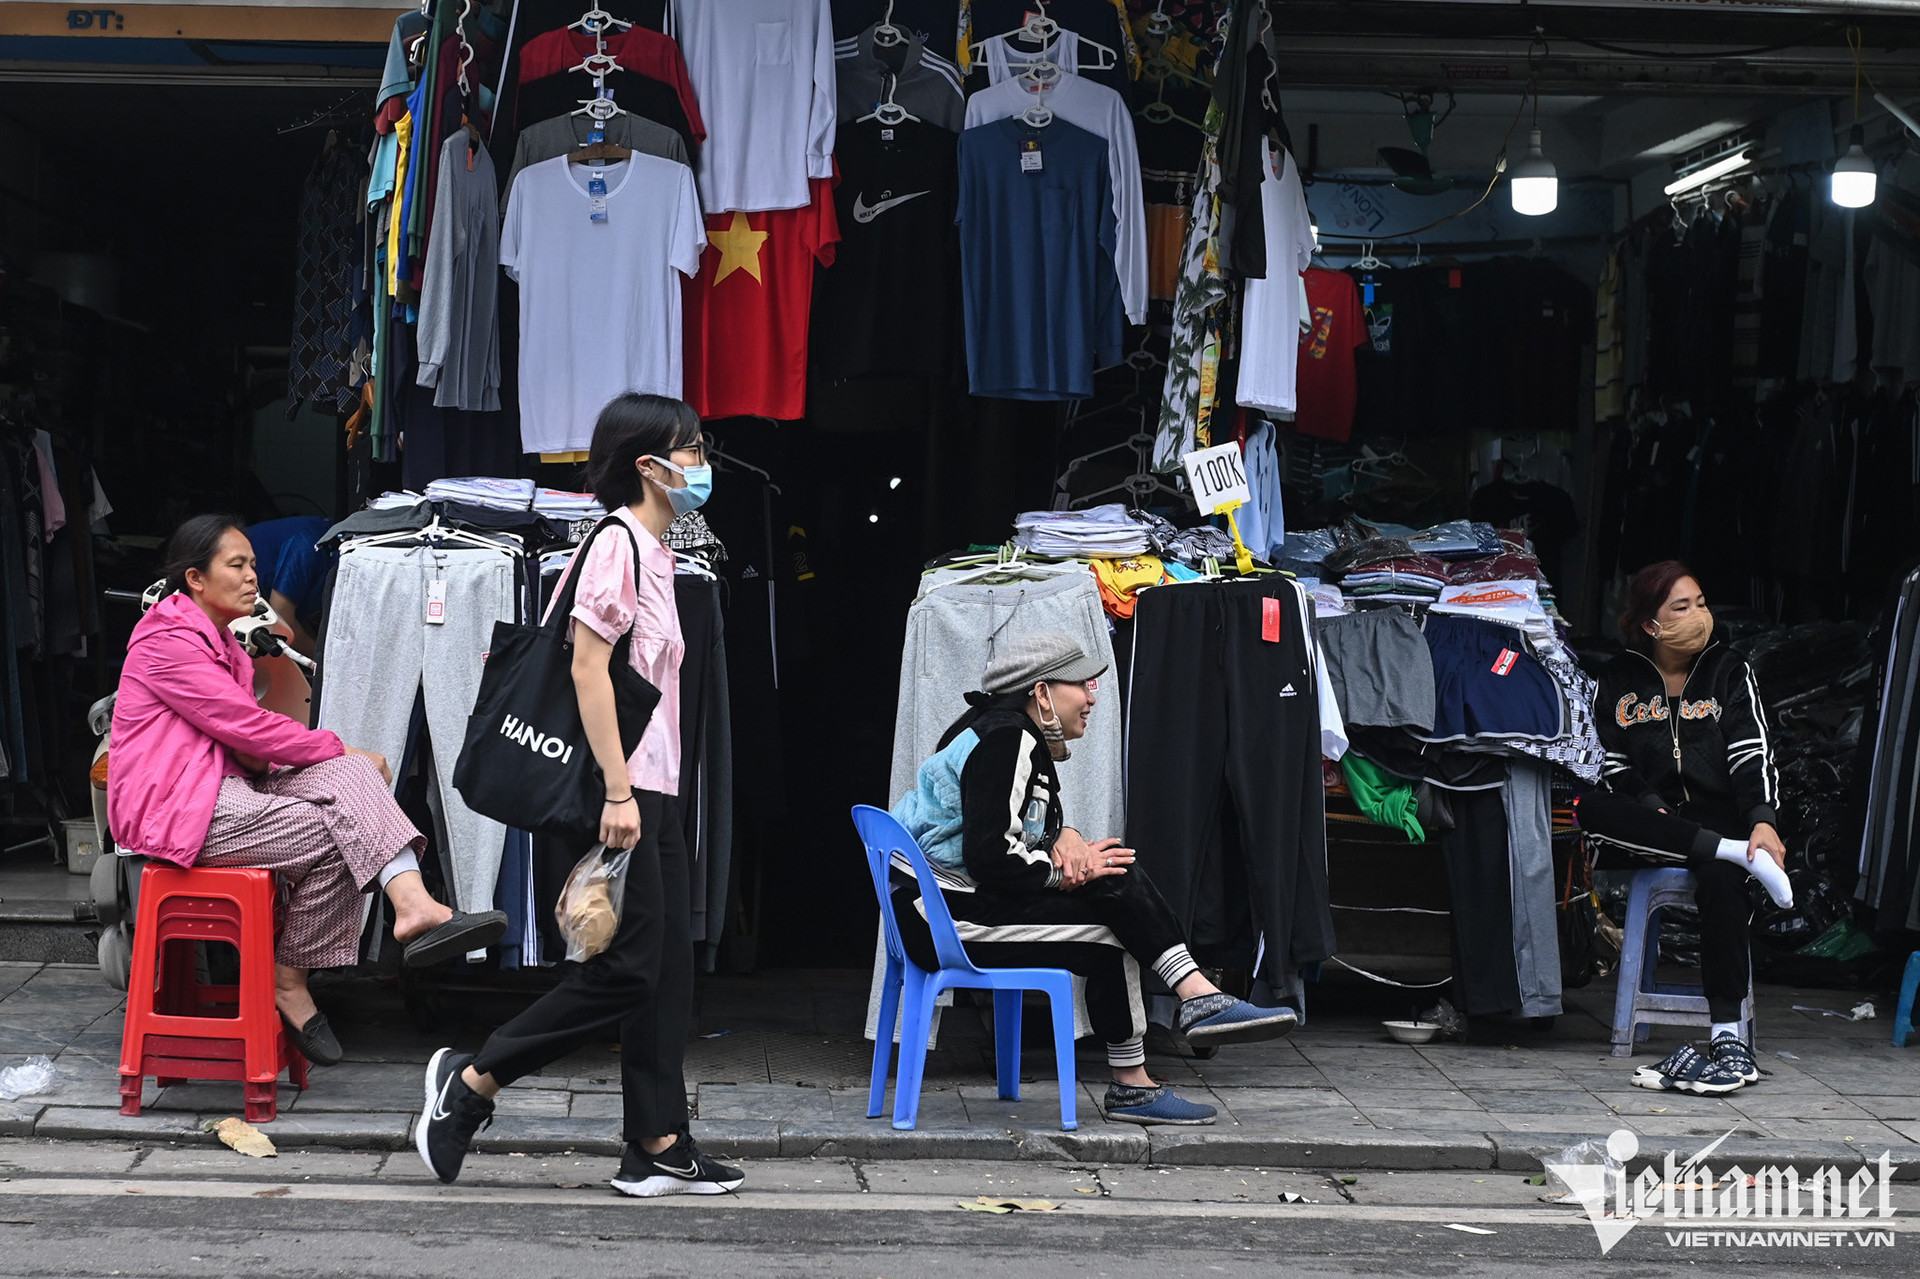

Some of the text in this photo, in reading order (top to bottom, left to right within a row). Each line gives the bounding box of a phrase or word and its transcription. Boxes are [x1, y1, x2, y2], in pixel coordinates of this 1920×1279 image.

[67, 9, 124, 31] ĐT:
[1194, 452, 1246, 497] 100K
[499, 713, 574, 764] HANOI
[1668, 1053, 1690, 1078] CHRISTIAN
